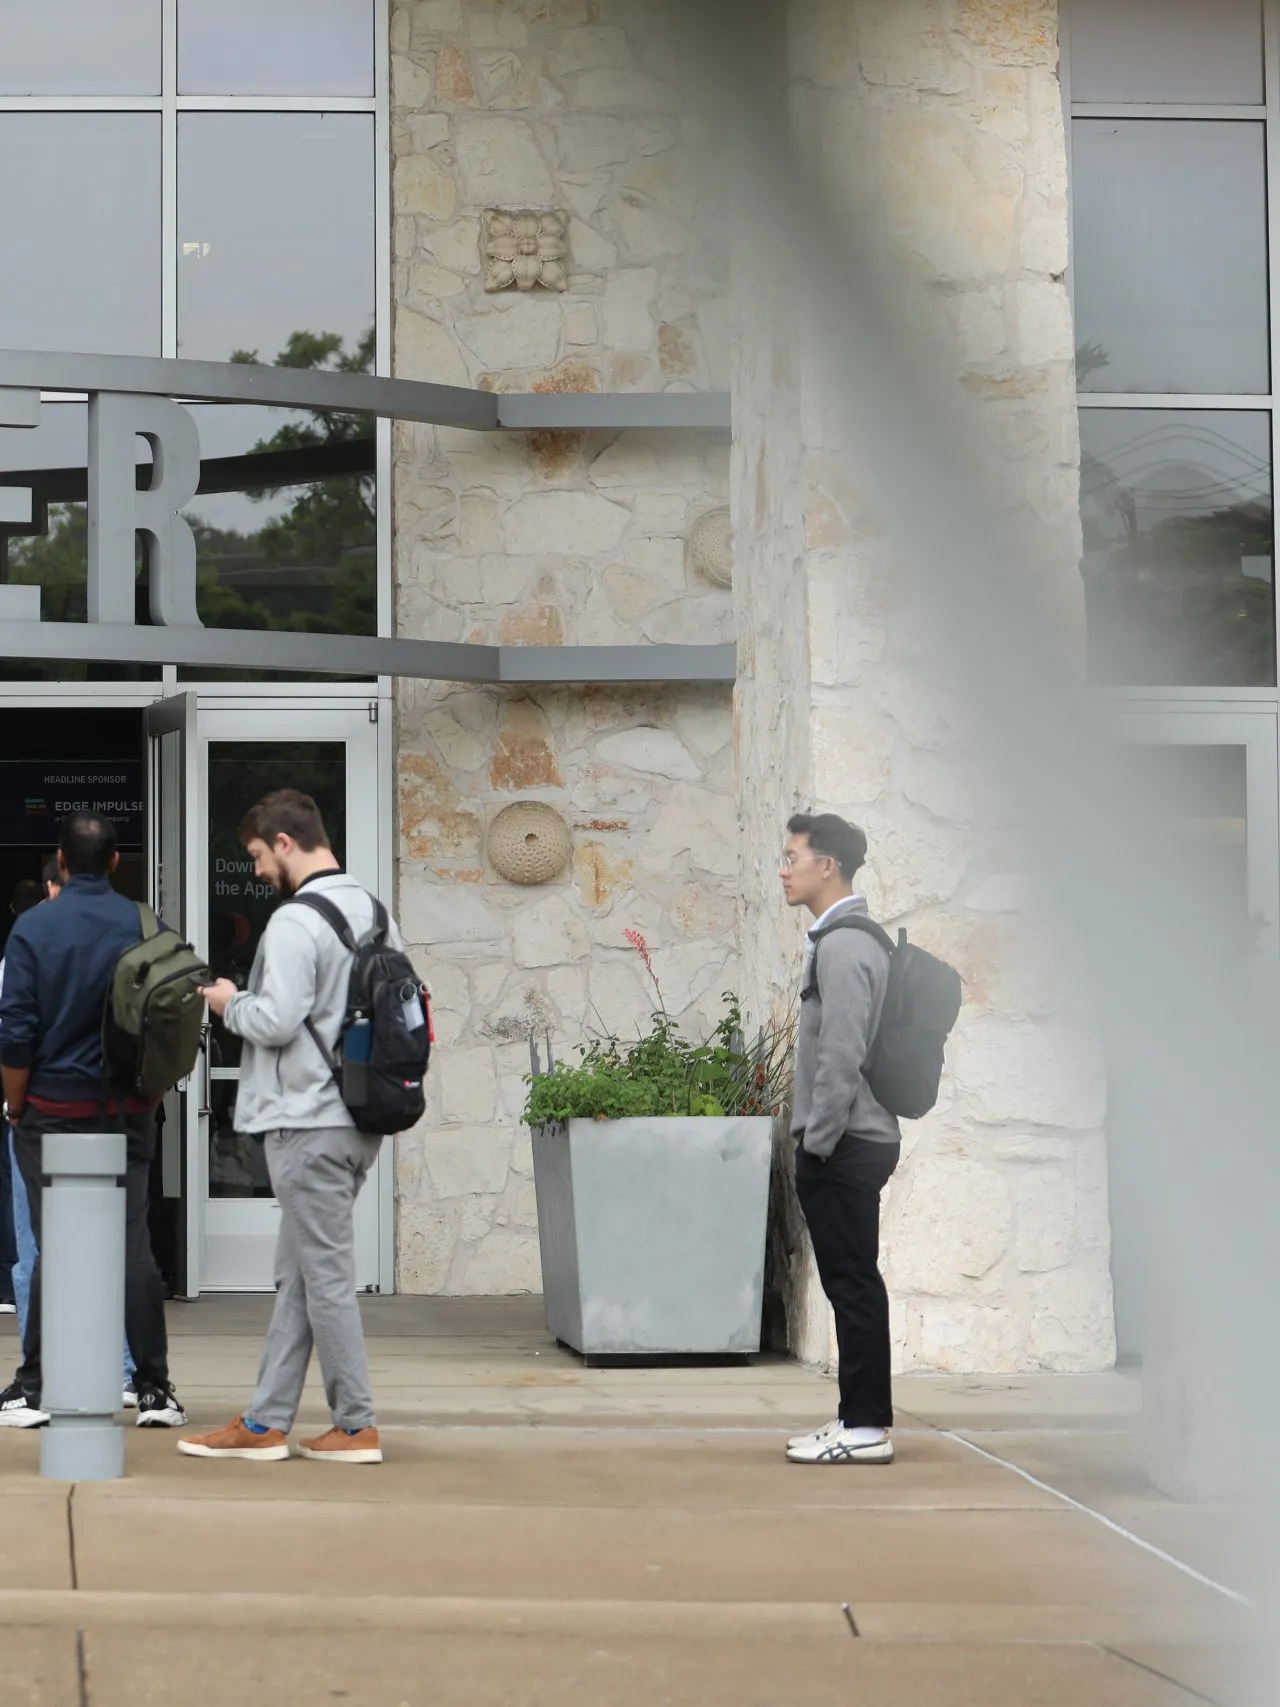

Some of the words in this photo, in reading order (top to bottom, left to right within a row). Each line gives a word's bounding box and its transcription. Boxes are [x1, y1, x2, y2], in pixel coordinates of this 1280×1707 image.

[44, 776, 85, 784] HEADLINE
[87, 776, 127, 784] SPONSOR
[55, 802, 89, 812] EDGE
[93, 801, 144, 812] IMPULSE
[215, 881, 240, 896] the
[244, 882, 274, 899] App
